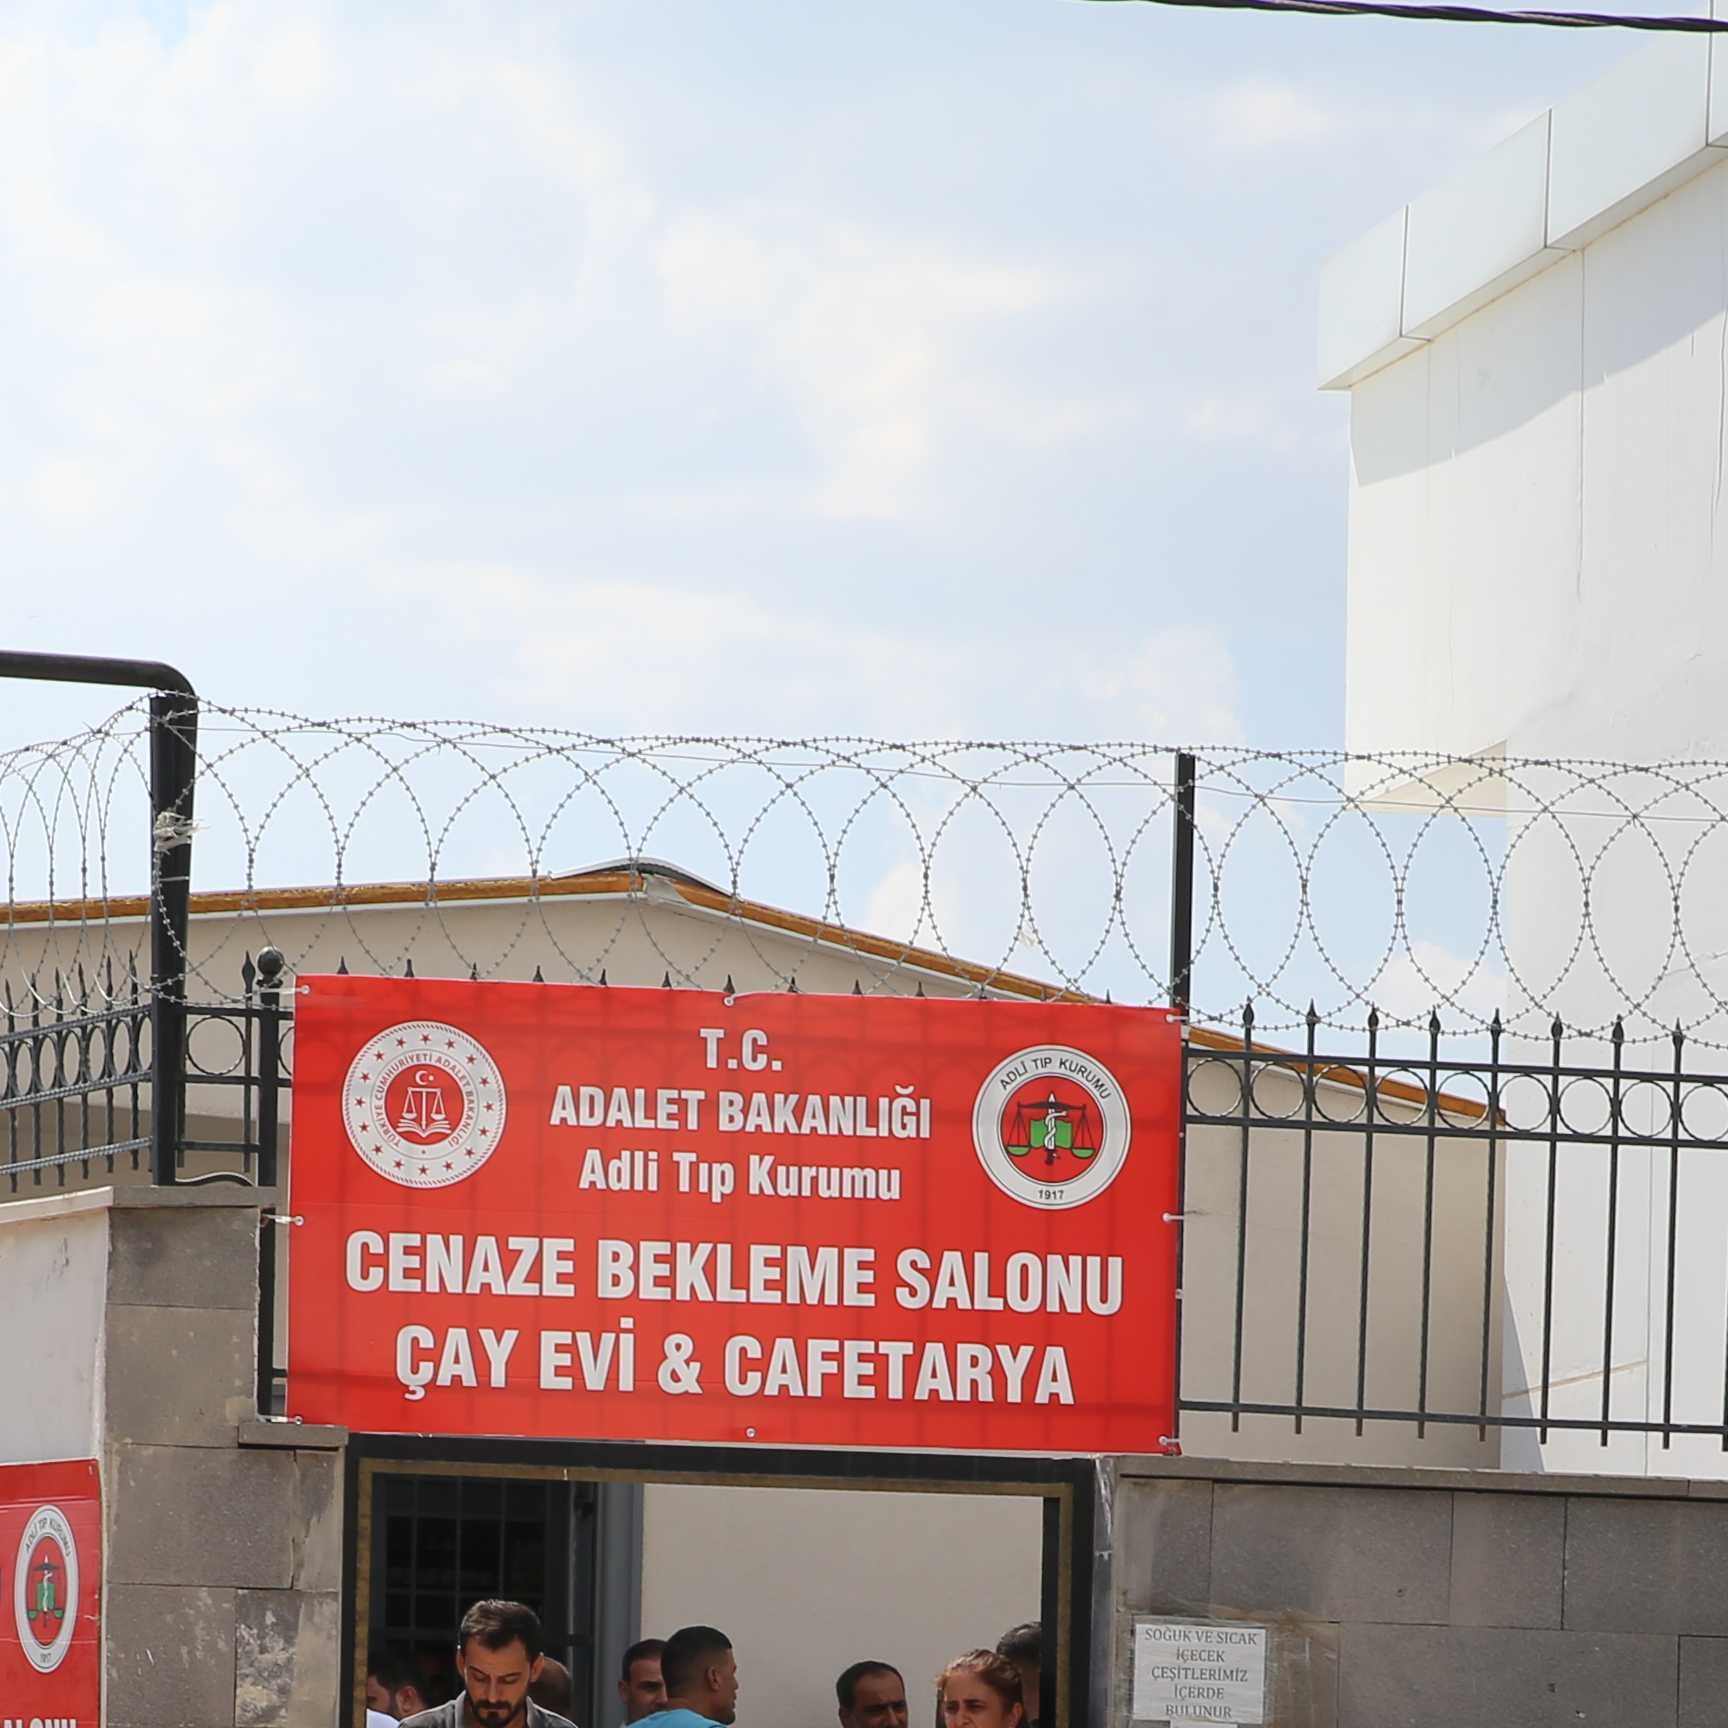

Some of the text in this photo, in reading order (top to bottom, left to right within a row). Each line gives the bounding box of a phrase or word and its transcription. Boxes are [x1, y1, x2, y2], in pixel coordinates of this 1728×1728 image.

[699, 1028, 782, 1071] T.C.
[374, 1052, 477, 1148] TÜRKİYE CUMHURİYETİ ADALET BAKANLIĞI
[998, 1057, 1112, 1100] ADLİ TIP KURUMU
[549, 1085, 930, 1139] ADALET BAKANLIĞI
[578, 1148, 900, 1203] Adli Tıp Kurumu
[1038, 1190, 1065, 1200] 1917
[346, 1230, 1123, 1316] CENAZE BEKLEME SALONU
[396, 1317, 1074, 1405] ÇAY EVİ & CAFETARYA
[1145, 1627, 1258, 1646] SOĞUK VE SICAK
[1176, 1648, 1225, 1665] İÇECEK
[1151, 1664, 1249, 1683] ÇEŞİTLERİMİZ
[1174, 1684, 1225, 1702] İÇERDE
[1165, 1703, 1232, 1719] BULUNUR
